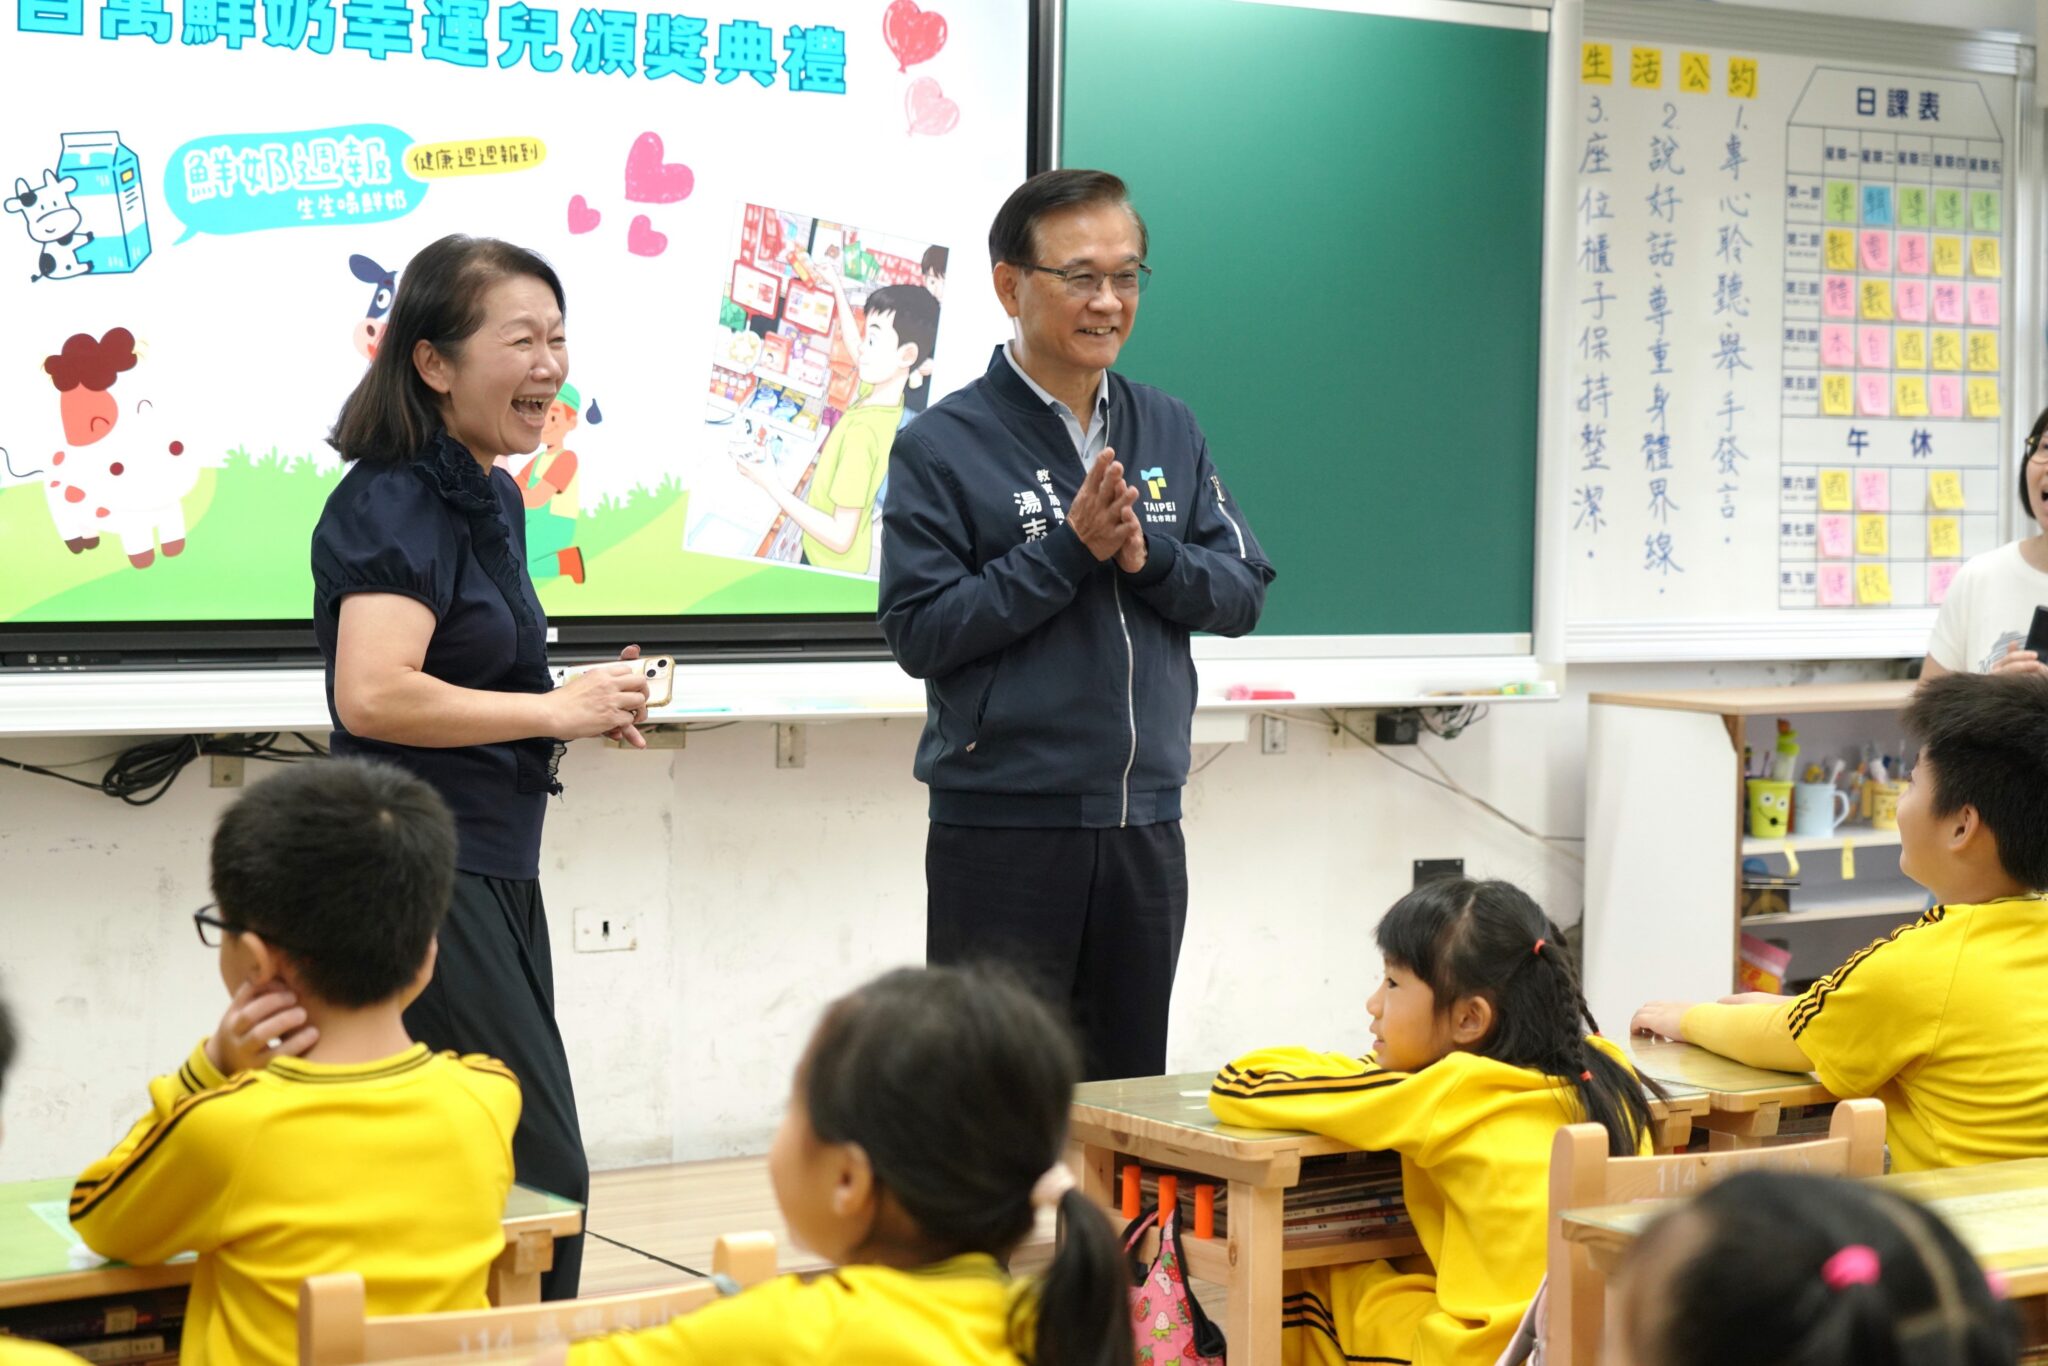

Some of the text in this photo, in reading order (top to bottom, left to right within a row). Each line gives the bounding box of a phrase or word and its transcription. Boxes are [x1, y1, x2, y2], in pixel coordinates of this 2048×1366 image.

[1857, 87, 1940, 121] 日課表
[184, 134, 393, 203] 鮮奶週報
[413, 142, 539, 172] 健康週週報到
[1848, 427, 1932, 458] 午休
[1036, 469, 1065, 526] 教育局局
[1143, 501, 1176, 512] TAIPEI
[1656, 1160, 1697, 1194] 114
